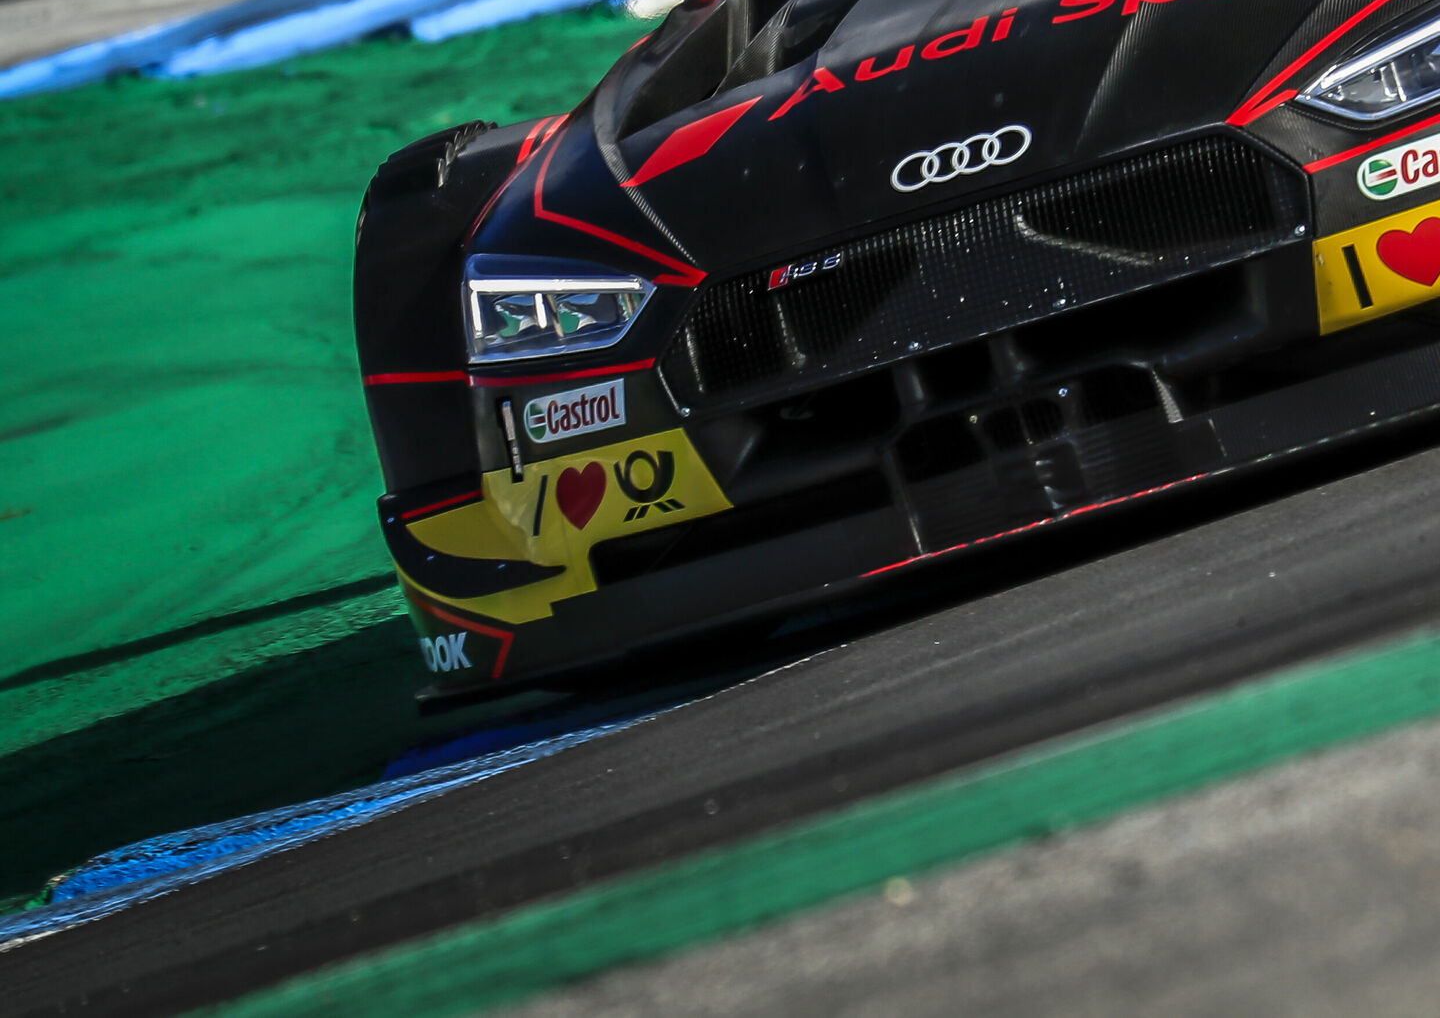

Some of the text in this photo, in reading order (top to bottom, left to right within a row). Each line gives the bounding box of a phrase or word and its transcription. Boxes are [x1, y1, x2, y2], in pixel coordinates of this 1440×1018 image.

[767, 6, 1017, 121] Audi
[1342, 244, 1375, 310] I
[546, 385, 620, 435] Castrol
[420, 631, 473, 673] OOK
